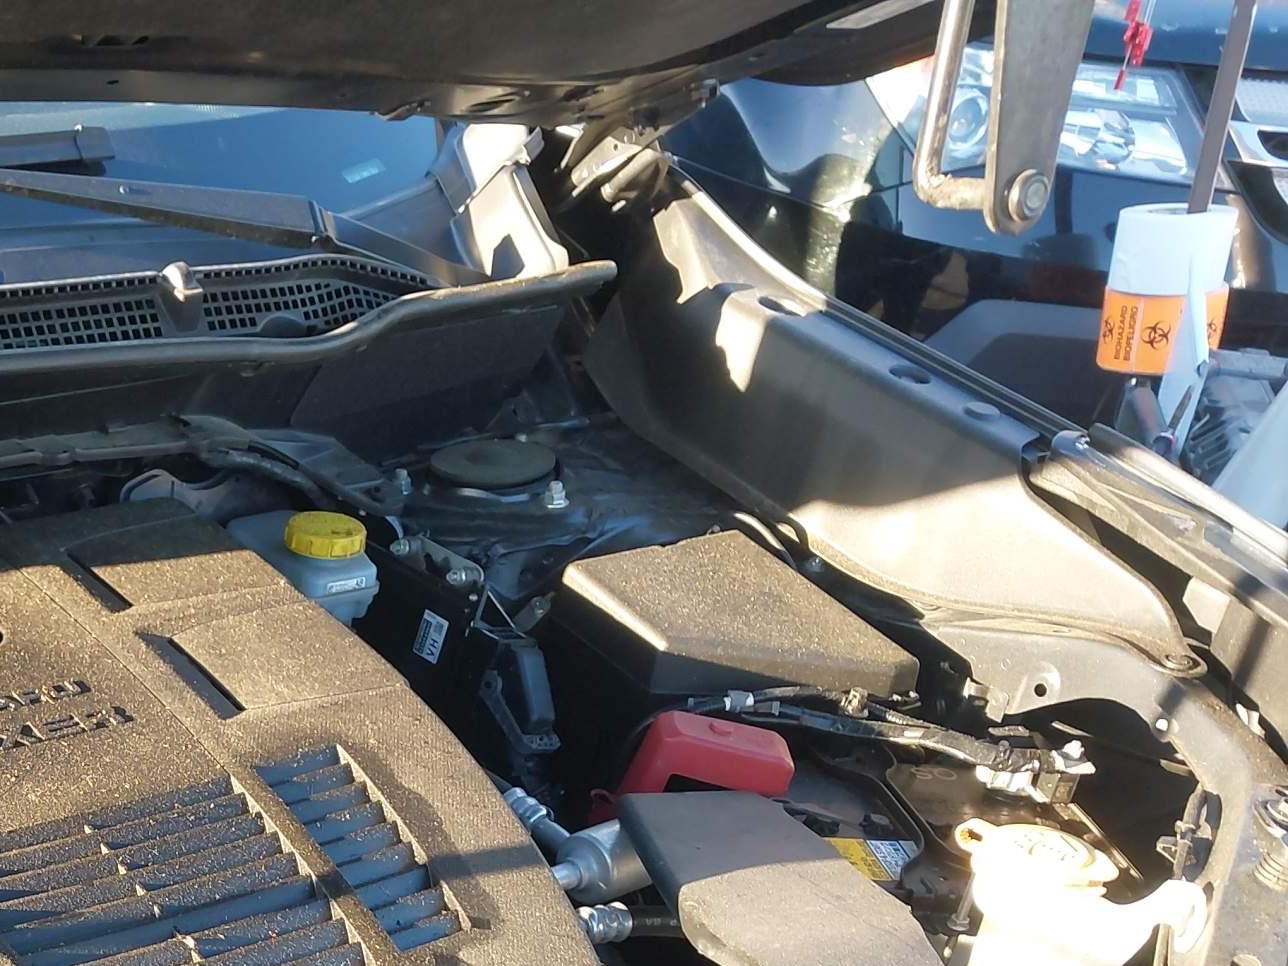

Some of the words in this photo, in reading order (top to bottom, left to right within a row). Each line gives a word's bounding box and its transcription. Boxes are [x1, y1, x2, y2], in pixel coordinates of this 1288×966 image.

[1114, 305, 1128, 360] BIOHAZARD
[1123, 306, 1139, 361] BIOPELIGRO
[425, 638, 439, 657] VH
